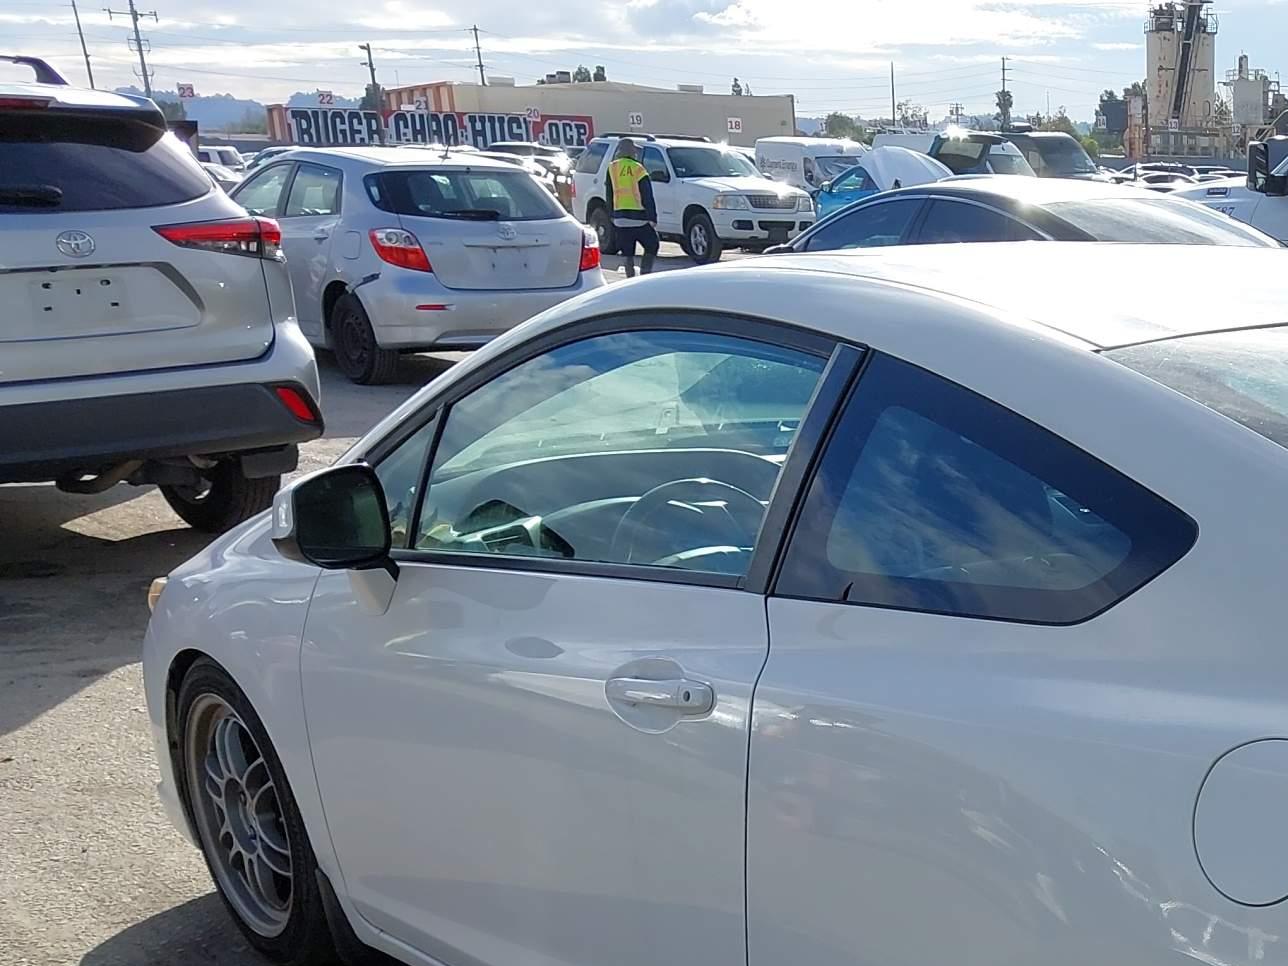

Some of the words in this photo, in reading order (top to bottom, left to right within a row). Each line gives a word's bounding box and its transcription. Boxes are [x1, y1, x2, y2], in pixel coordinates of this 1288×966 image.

[178, 86, 195, 98] 23
[318, 93, 333, 104] 22
[526, 108, 539, 118] 20
[629, 114, 642, 125] 19
[728, 120, 741, 130] 18
